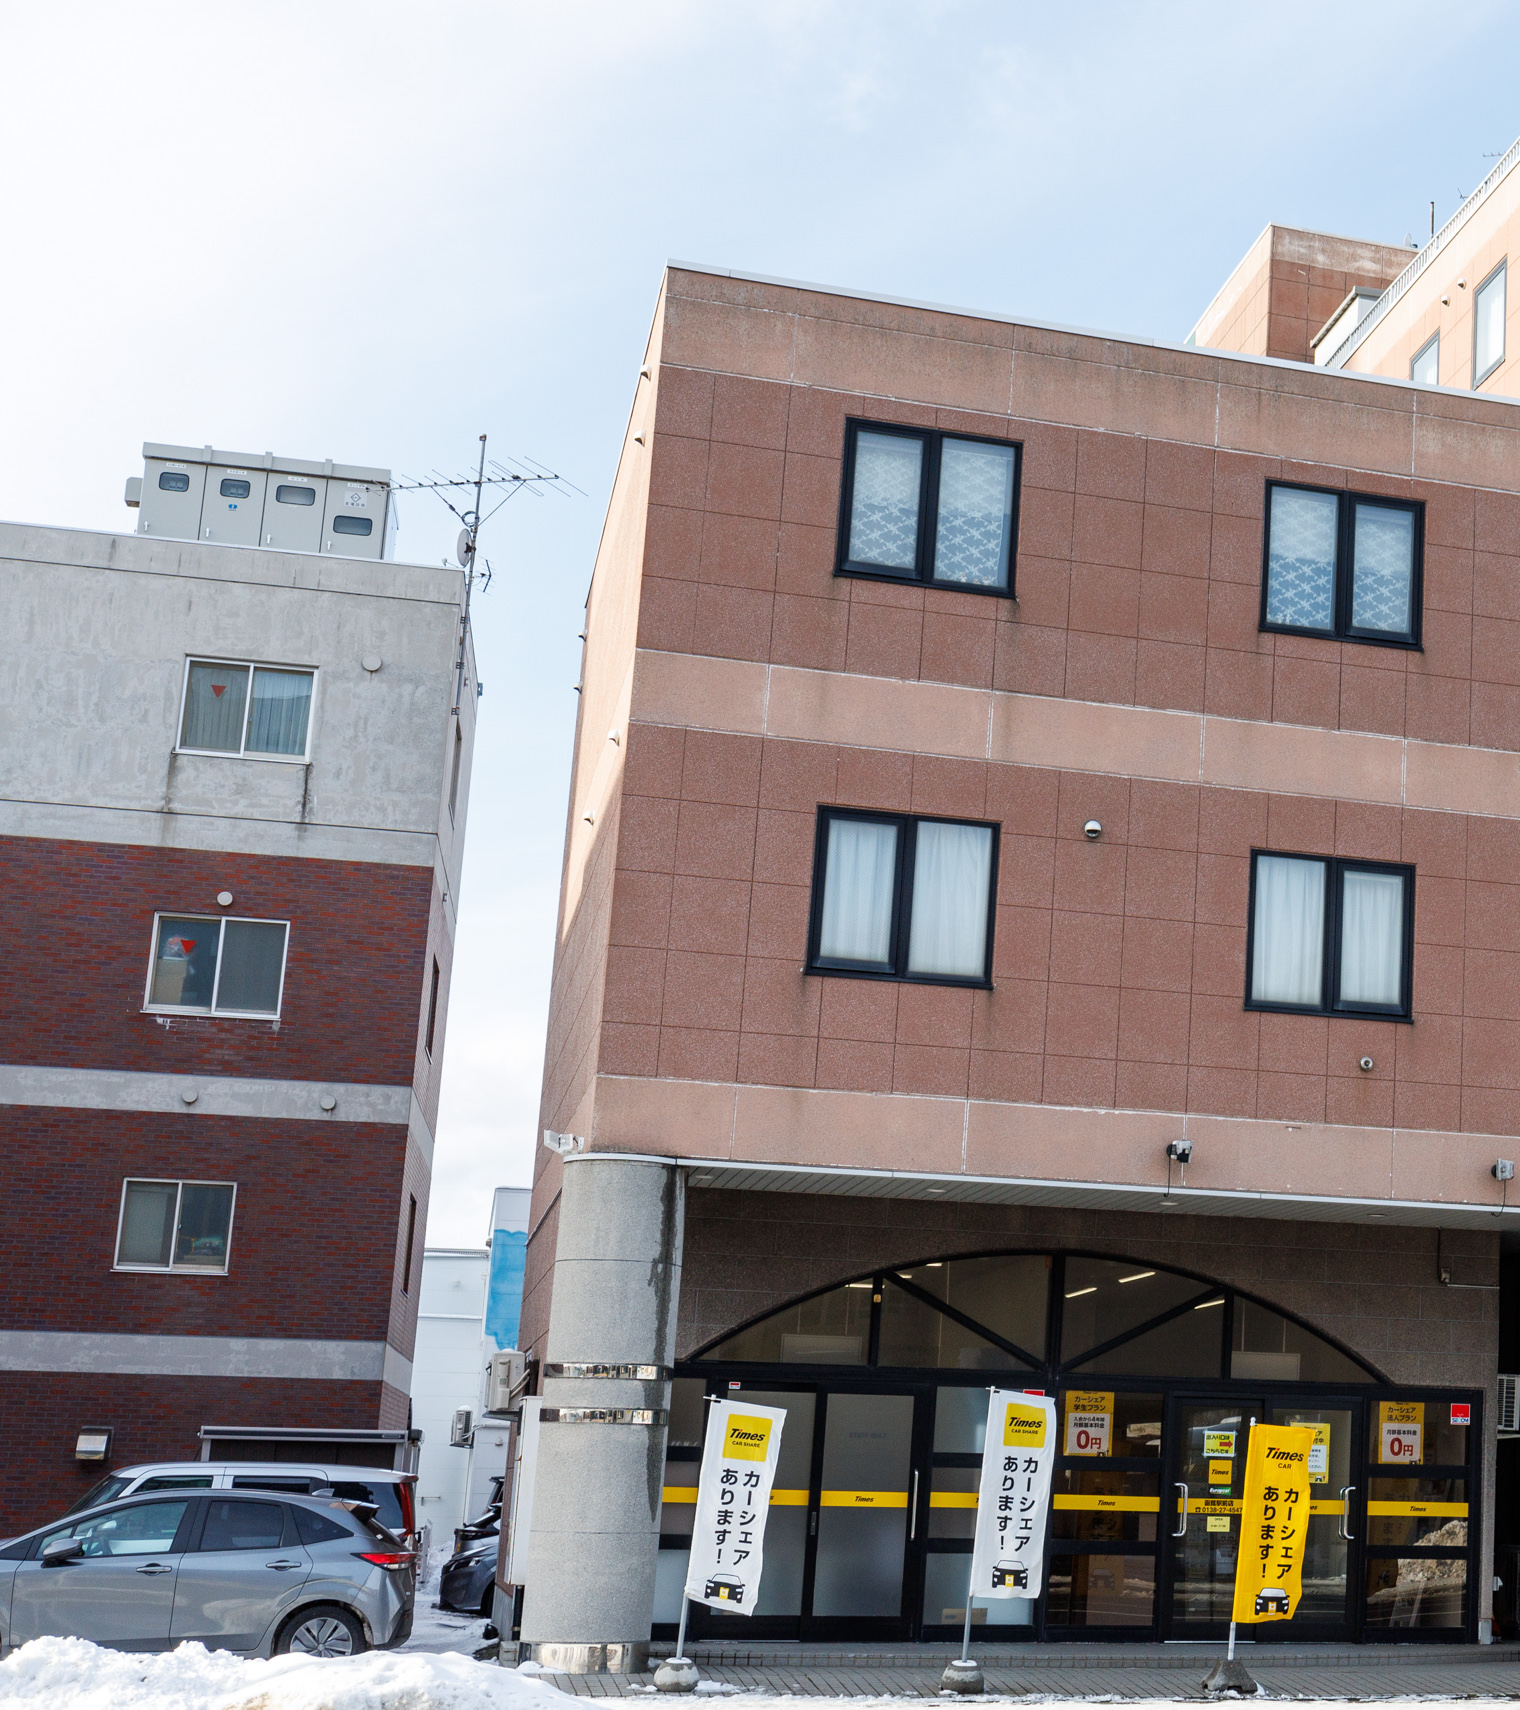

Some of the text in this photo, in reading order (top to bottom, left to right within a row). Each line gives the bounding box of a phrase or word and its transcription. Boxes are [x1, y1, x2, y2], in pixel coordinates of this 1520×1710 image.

[1008, 1416, 1043, 1429] Times
[1387, 1414, 1417, 1422] 法人プラン
[729, 1428, 766, 1442] Times
[1076, 1429, 1102, 1450] 0円
[1265, 1447, 1305, 1462] Times
[1389, 1437, 1414, 1456] 0円
[1014, 1457, 1039, 1552] カーシェア
[733, 1470, 760, 1566] カーシェア
[1276, 1488, 1299, 1580] カーシェア
